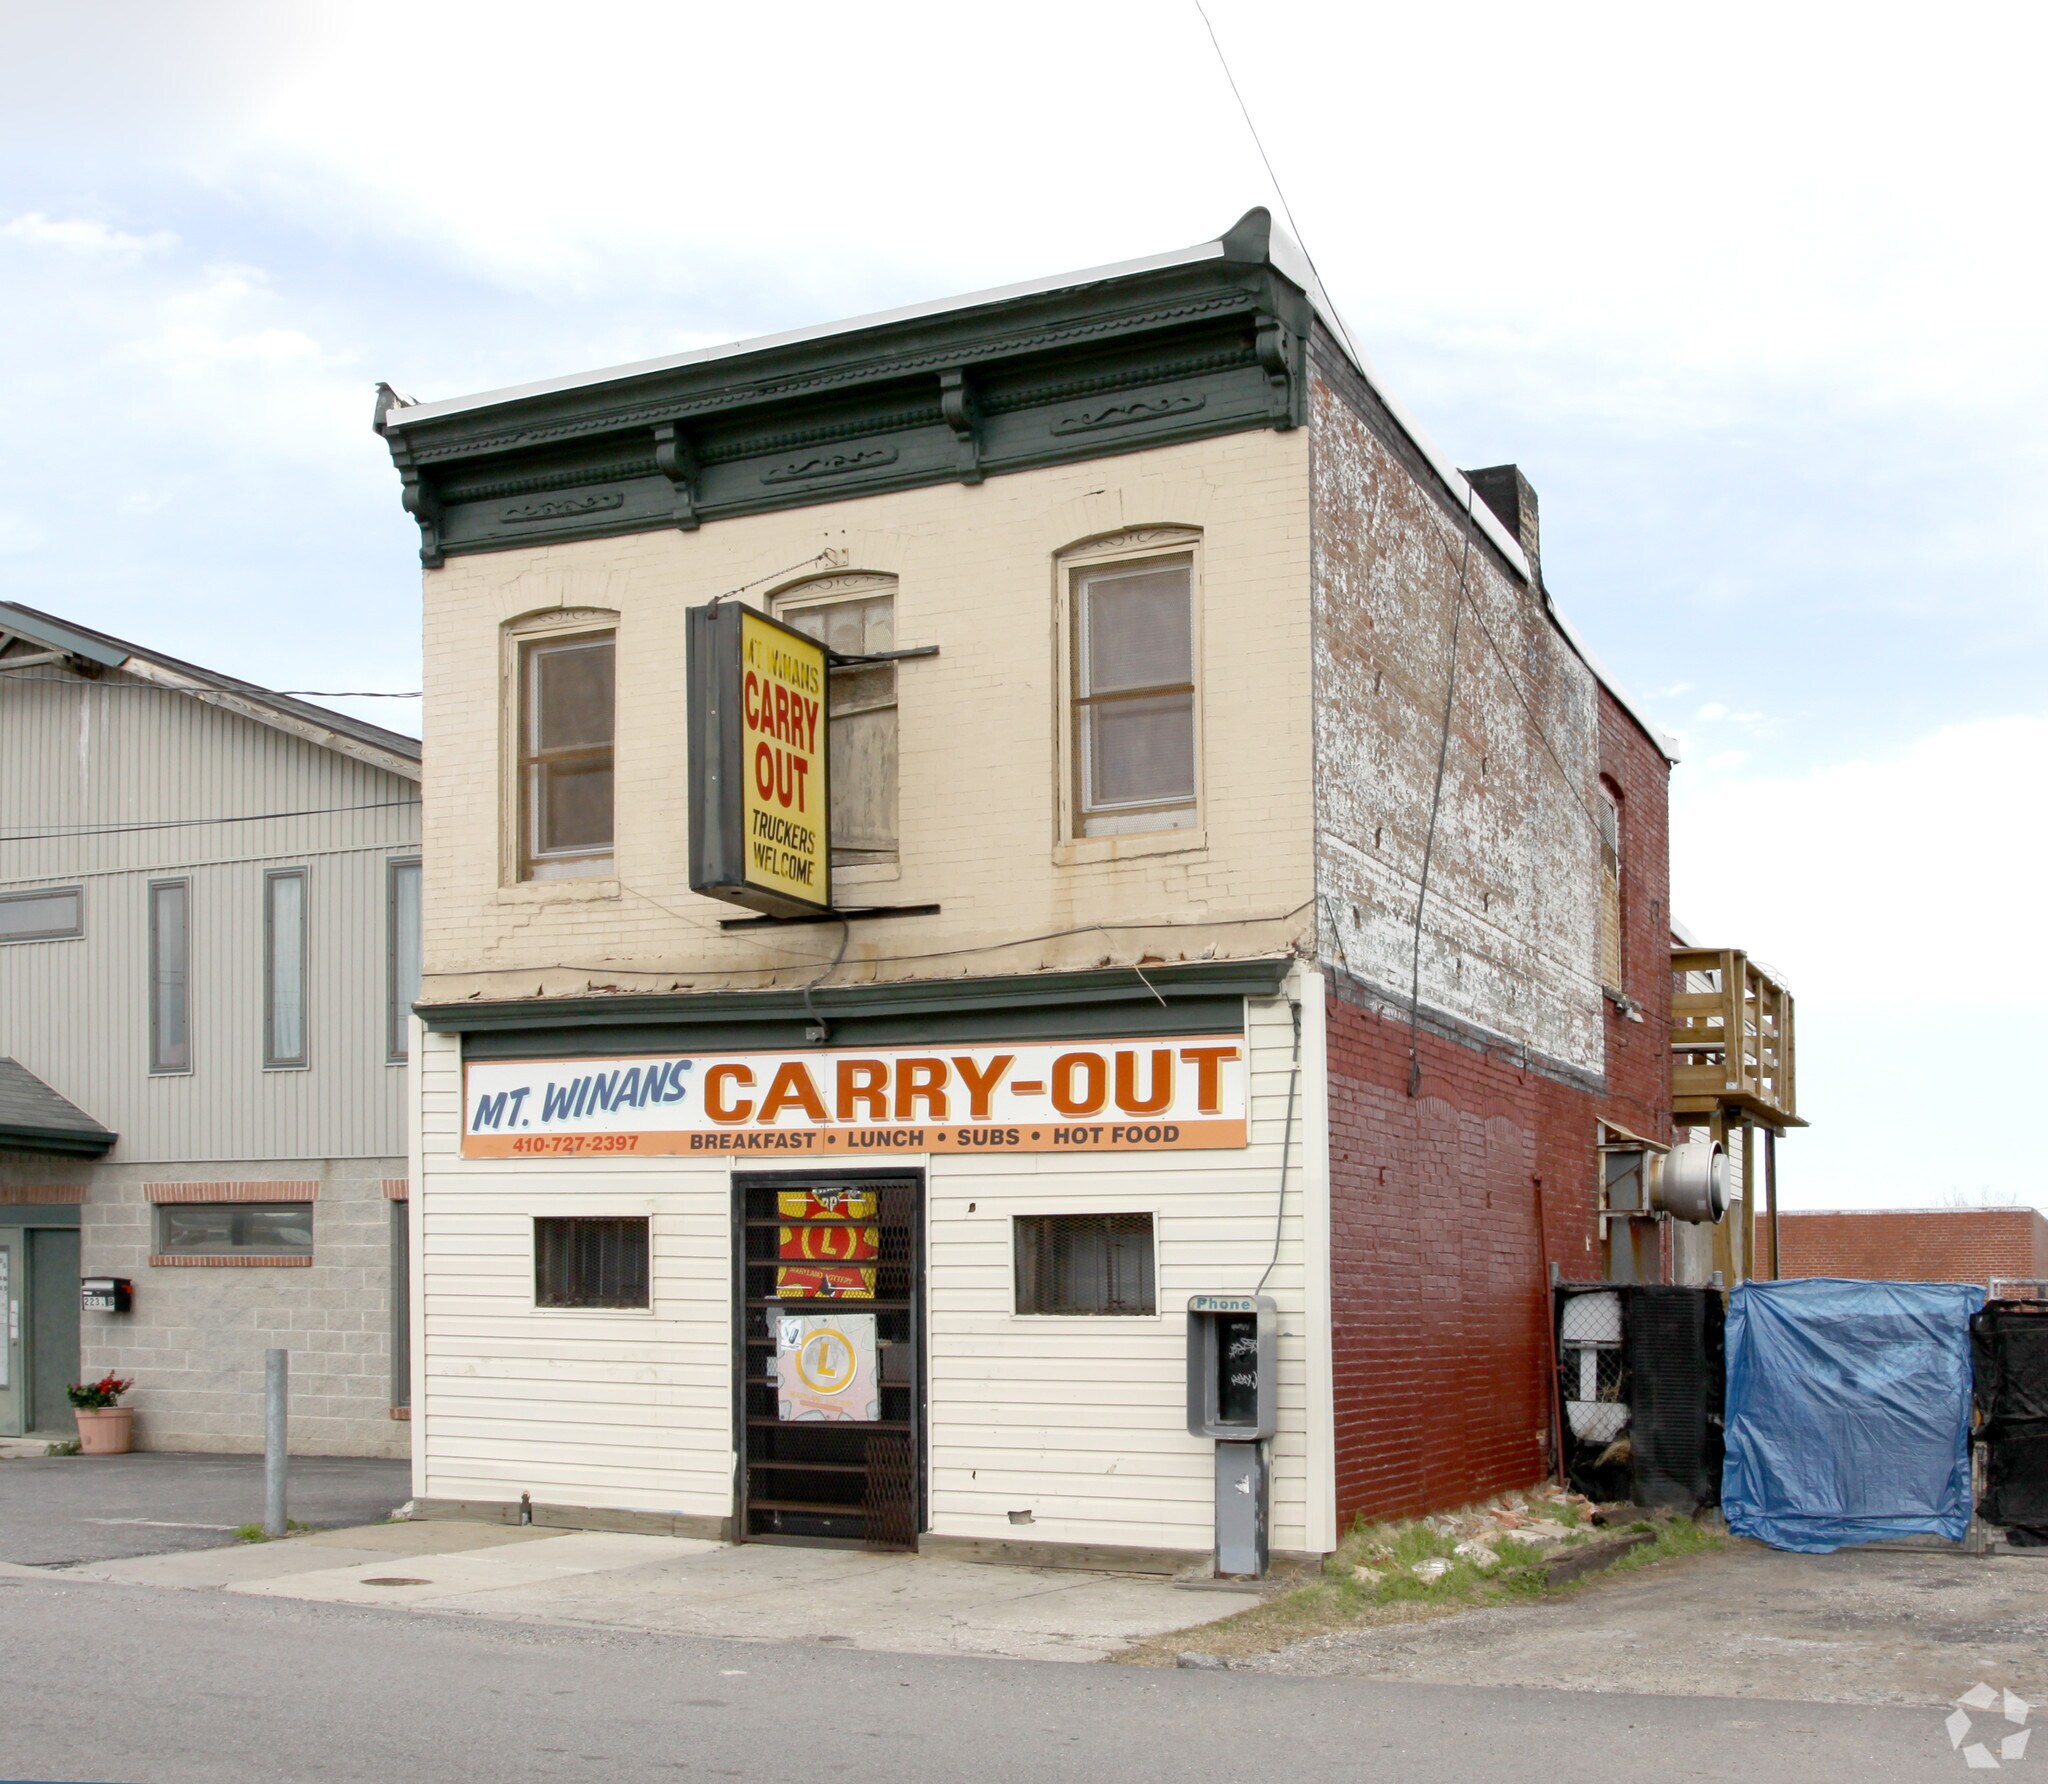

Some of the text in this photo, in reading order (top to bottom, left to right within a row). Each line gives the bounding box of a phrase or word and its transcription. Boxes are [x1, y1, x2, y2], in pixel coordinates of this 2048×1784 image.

[744, 671, 819, 754] CARRY
[755, 741, 808, 813] OUT
[753, 809, 815, 855] TRUCKERS
[754, 841, 815, 886] WELCOME
[472, 1046, 1242, 1132] MT. WINANS CARRY-OUT
[513, 1125, 1180, 1153] 410-727-2397 BREAKFAST LUNCH SUBS HOT FOOD
[1196, 1297, 1251, 1310] Phone
